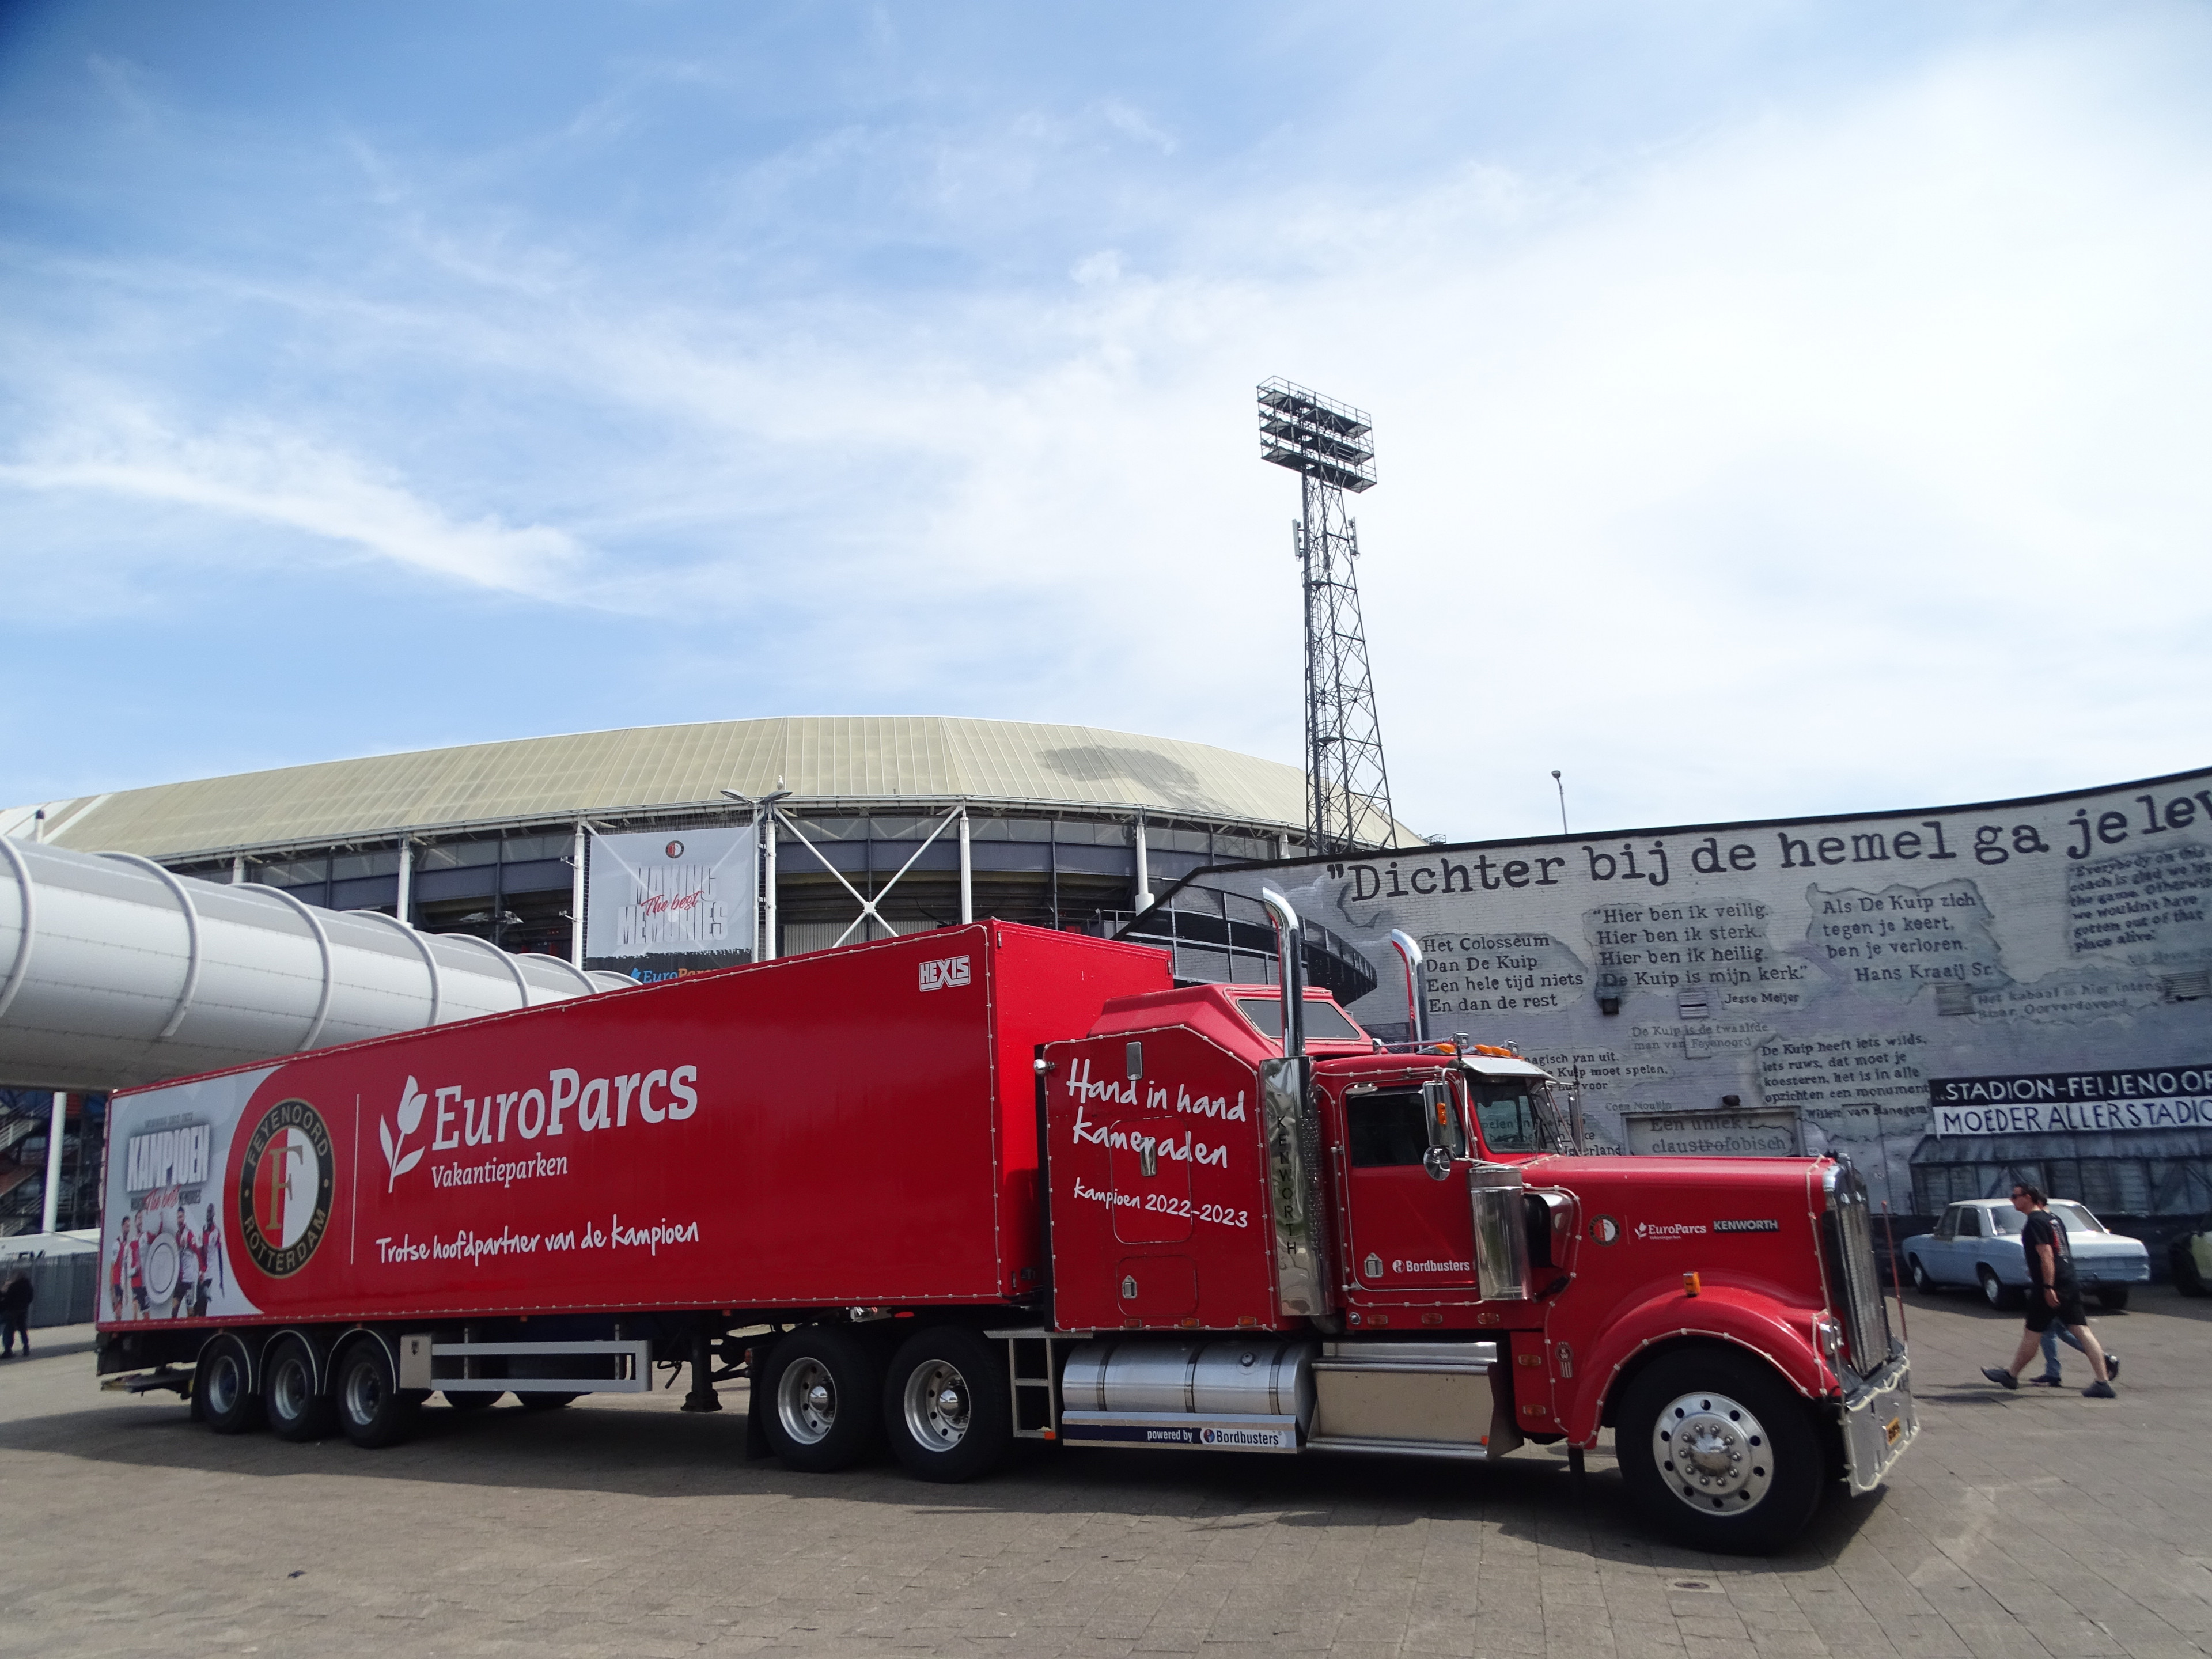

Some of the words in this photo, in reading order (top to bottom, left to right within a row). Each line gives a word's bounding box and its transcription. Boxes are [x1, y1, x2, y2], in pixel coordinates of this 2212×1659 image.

[1582, 840, 1669, 887] bij
[1692, 837, 1756, 873] de
[1778, 821, 1957, 868] hemel
[1974, 824, 2050, 865] ga
[2066, 808, 2128, 859] je
[641, 894, 669, 916] The
[672, 891, 704, 910] best
[1649, 907, 1683, 922] ben
[1689, 905, 1708, 919] ik
[1715, 902, 1769, 920] veilig.
[1822, 899, 1853, 915] Als
[1857, 896, 1884, 912] De
[1887, 894, 1934, 914] Kuip
[1940, 891, 1976, 908] zich
[1596, 929, 1638, 945] Hier
[1642, 928, 1678, 943] ben
[1684, 926, 1702, 941] ik
[1822, 922, 1874, 940] tegen
[1879, 919, 1896, 937] je
[1421, 938, 1454, 953] Het
[1460, 935, 1550, 952] Colosseum
[1825, 943, 1861, 959] ben
[1865, 940, 1883, 959] je
[1889, 937, 1968, 954] verloren.
[1426, 959, 1459, 972] Dan
[1465, 956, 1490, 970] De
[1497, 955, 1538, 971] Kuip
[1599, 950, 1642, 966] Hier
[1648, 949, 1681, 964] ben
[1686, 948, 1706, 963] ik
[919, 956, 969, 988] HEXIS
[1601, 972, 1628, 987] De
[1634, 971, 1680, 988] Kuip
[1684, 969, 1701, 983] is
[1709, 968, 1751, 986] mijn
[1854, 967, 1902, 982] Hans
[1908, 963, 1965, 981] Kraaij
[1427, 979, 1458, 993] Een
[1465, 976, 1499, 991] hele
[1505, 975, 1534, 991] tijd
[1540, 972, 1584, 987] niets
[1429, 998, 1452, 1013] En
[1459, 997, 1490, 1012] dan
[1498, 995, 1518, 1010] de
[1522, 993, 1558, 1009] rest
[1724, 993, 1758, 1005] Jesse
[1760, 991, 1800, 1005] Meijer
[1631, 1026, 1649, 1037] De
[1653, 1025, 1681, 1037] Kuip
[1699, 1024, 1713, 1035] de
[1715, 1022, 1769, 1034] twaalfde
[1633, 1040, 1660, 1050] man
[1664, 1039, 1686, 1049] van
[1690, 1037, 1752, 1051] Feyenoord
[1761, 1045, 1779, 1057] De
[1783, 1043, 1814, 1056] Kuip
[1816, 1039, 1852, 1052] heeft
[1856, 1037, 1881, 1050] iets
[1573, 1054, 1595, 1064] van
[1599, 1051, 1620, 1063] uit.
[1763, 1061, 1785, 1072] iets
[1828, 1056, 1849, 1067] dat
[1854, 1052, 1889, 1066] moet
[1893, 1051, 1907, 1065] je
[1557, 1066, 1586, 1080] Kup
[1590, 1066, 1621, 1077] moet
[1832, 1072, 1855, 1084] het
[1859, 1070, 1872, 1082] is
[1874, 1068, 1891, 1081] in
[1893, 1066, 1921, 1079] alle
[1067, 1058, 1137, 1105] Hand
[1146, 1080, 1168, 1110] in
[1177, 1084, 1247, 1122] hand
[1764, 1090, 1825, 1105] opzichten
[1828, 1088, 1852, 1099] een
[1855, 1083, 1929, 1097] monument
[431, 1065, 698, 1151] EuroParcs
[1846, 1106, 1870, 1117] van
[1649, 1118, 1685, 1132] Een
[1691, 1115, 1743, 1130] uniek
[1943, 1106, 2042, 1134] MOEDER
[247, 1104, 328, 1168] FEYENOORD
[1652, 1135, 1786, 1153] claustrofobisch
[126, 1123, 210, 1194] KAMPIOEN
[431, 1152, 568, 1188] Vakantieparken
[1277, 1115, 1297, 1255] KENWORTH
[1144, 1193, 1248, 1228] 2022-2023
[1648, 1224, 1707, 1234] EuroParcs
[1713, 1218, 1779, 1232] KENWORTH
[244, 1207, 327, 1272] ROTTERDAM
[376, 1234, 430, 1264] Trotse
[432, 1225, 540, 1267] hoofdpartner
[544, 1230, 575, 1252] van
[580, 1221, 607, 1250] de
[1406, 1259, 1471, 1273] Bordbusters
[1147, 1429, 1181, 1441] powered
[1183, 1429, 1193, 1442] by
[1216, 1430, 1279, 1445] Bordbusters
